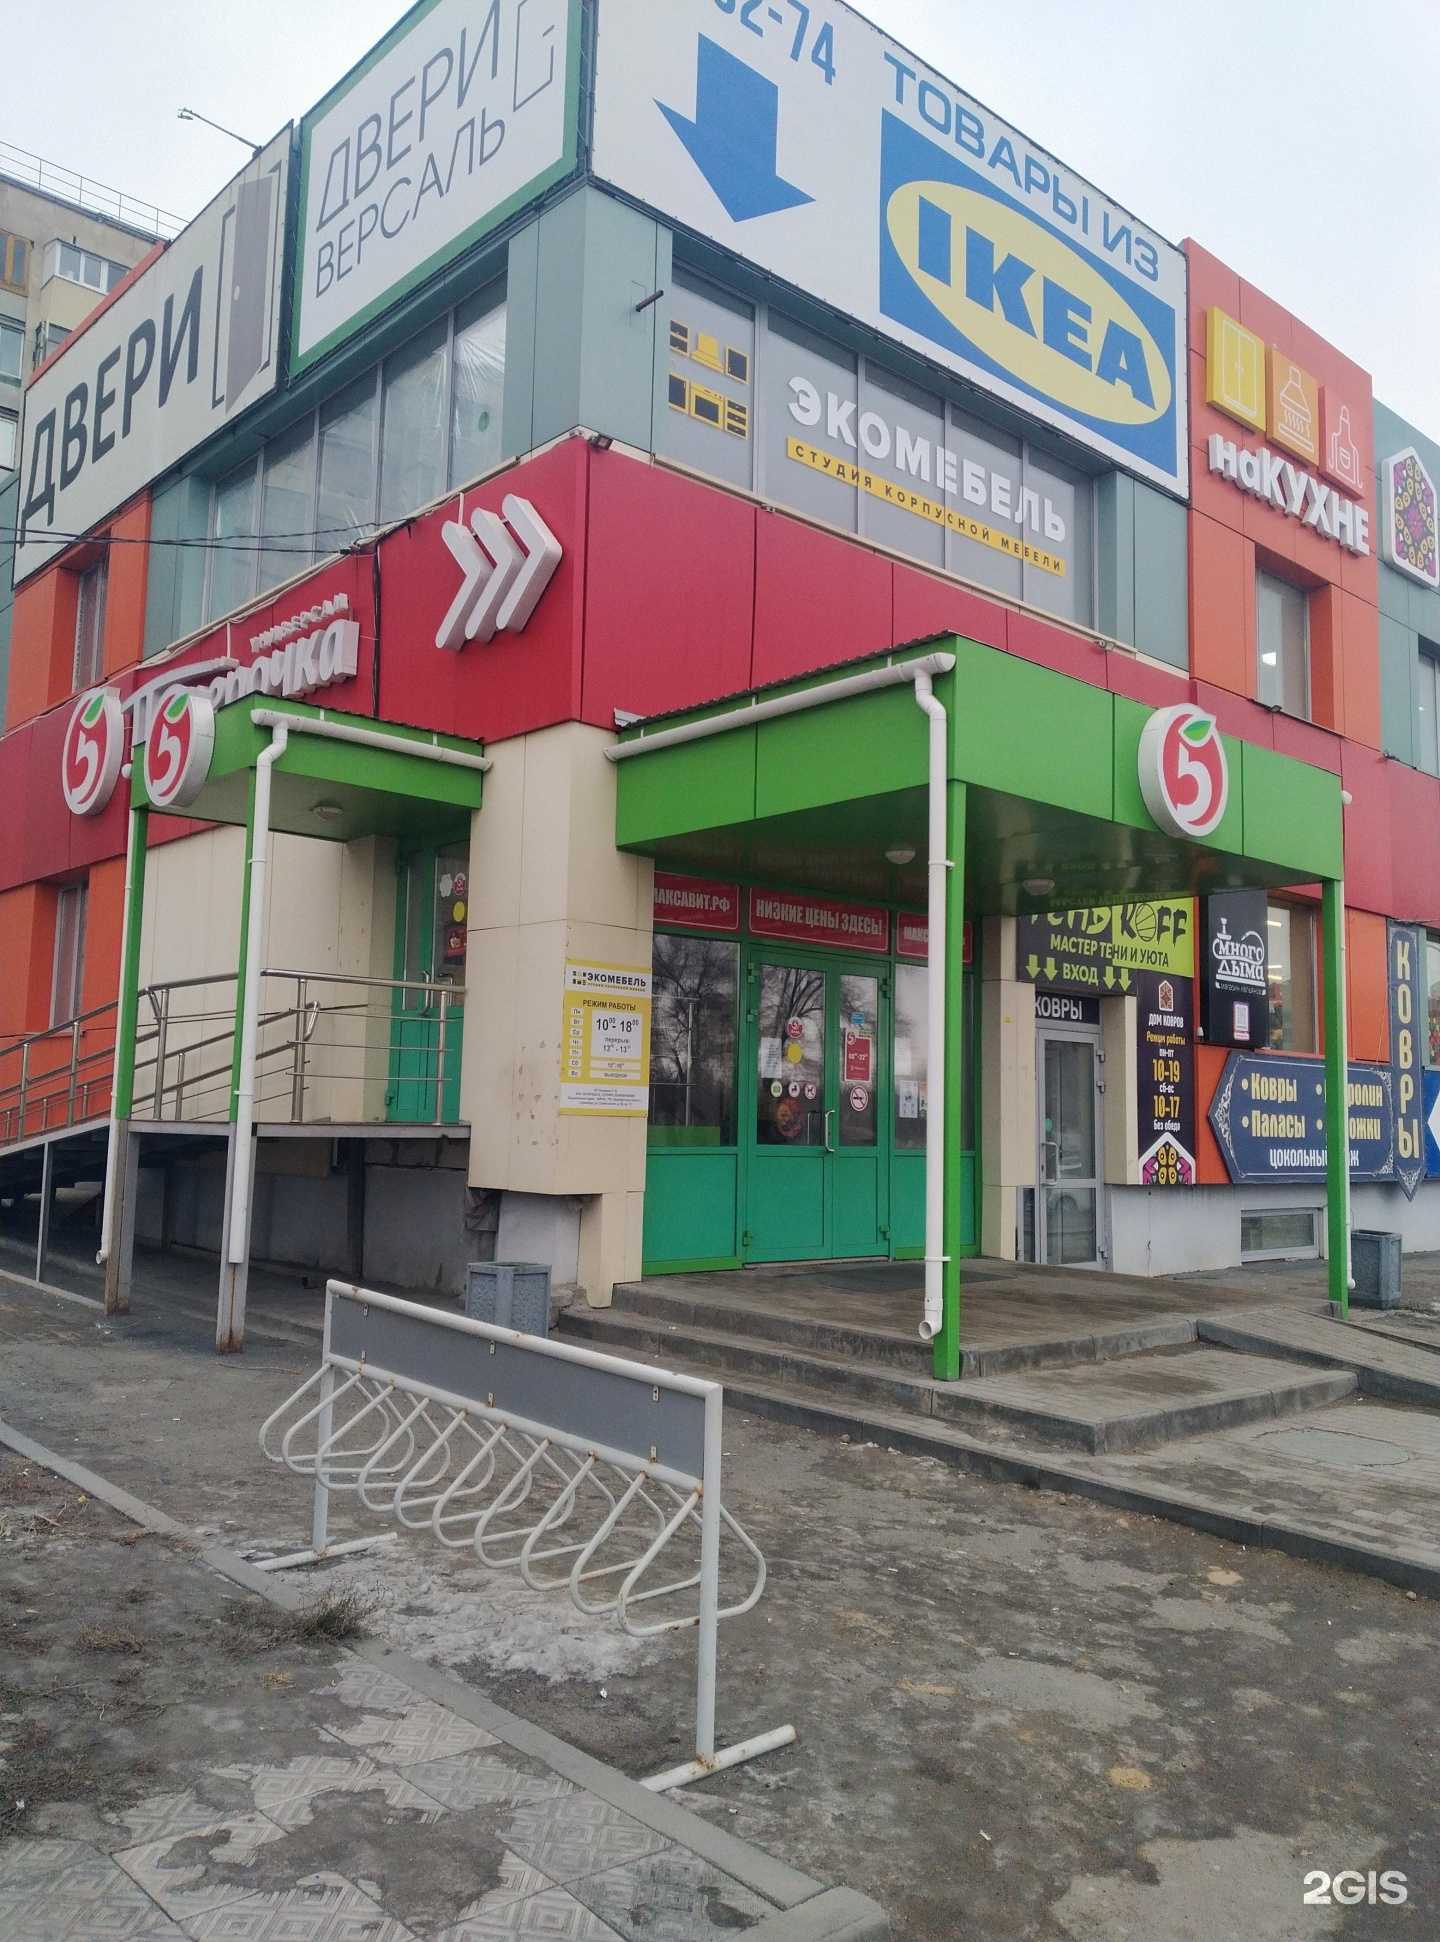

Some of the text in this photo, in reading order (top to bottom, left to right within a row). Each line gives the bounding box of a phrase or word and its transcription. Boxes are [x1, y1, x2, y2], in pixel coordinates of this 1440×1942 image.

[316, 0, 500, 232] ДВЕРИ
[884, 51, 1159, 272] ТОВАРЫ ИЗ
[316, 107, 505, 298] ВЕРСАЛЬ
[918, 194, 1157, 411] IKEA
[20, 265, 203, 548] ДВЕРИ
[786, 376, 1066, 543] ЭКОМЕБЕЛЬ
[795, 444, 1061, 572] СТУДИЯ КОРПУСНОЙ МЕБЕЛИ
[805, 904, 839, 929] ЦЕНЫ
[1050, 934, 1169, 968] МАСТЕР ТЕНИ И УЮТА
[587, 972, 647, 987] ЭКОМЕБЕЛЬ
[1062, 963, 1099, 986] ВХОД
[583, 1000, 636, 1011] РЕЖИМ РАБОТЫ
[1148, 1013, 1184, 1028] ДОМ КОВРОВ
[1396, 940, 1420, 1159] КОВРЫ
[1152, 1058, 1180, 1082] 10-19
[1251, 1073, 1297, 1103] Ковры
[1153, 1095, 1180, 1118] 10-17
[1251, 1110, 1306, 1138] Паласы
